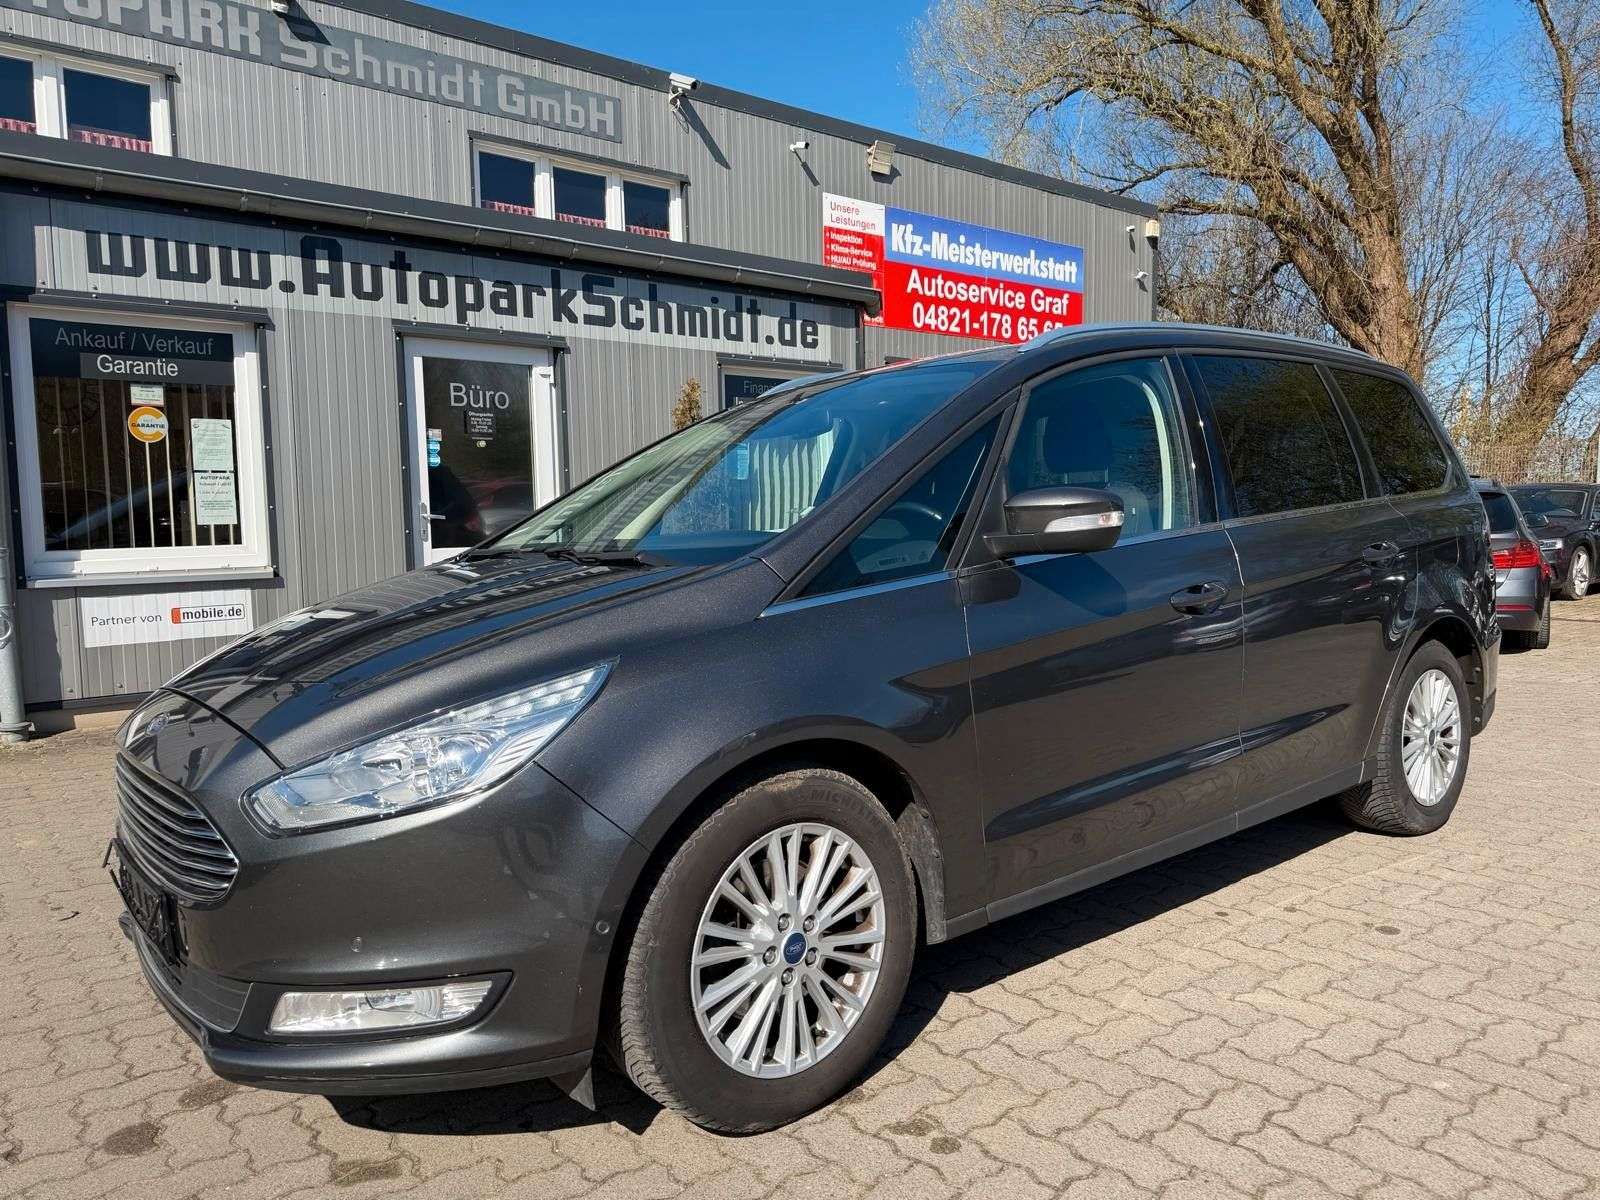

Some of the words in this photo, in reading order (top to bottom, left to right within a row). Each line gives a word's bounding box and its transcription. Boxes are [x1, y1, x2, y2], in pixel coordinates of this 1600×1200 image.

[279, 22, 484, 107] Schmidt
[497, 75, 615, 137] GmbH
[830, 201, 860, 215] Unsere
[830, 214, 876, 231] Leistungen
[891, 222, 1078, 284] Kfz-Meisterwerkstatt
[85, 229, 819, 350] www.AutoparkSchmidt.de
[906, 268, 1026, 310] Autoservice
[1030, 288, 1069, 316] Graf
[912, 302, 1012, 339] 04821-178
[1017, 316, 1040, 341] 65
[55, 327, 126, 350] Ankauf
[141, 333, 214, 356] Verkauf
[96, 354, 179, 377] Garantie
[450, 382, 510, 409] Büro
[91, 616, 139, 627] Partner
[140, 614, 162, 623] von
[182, 606, 242, 620] mobile.de
